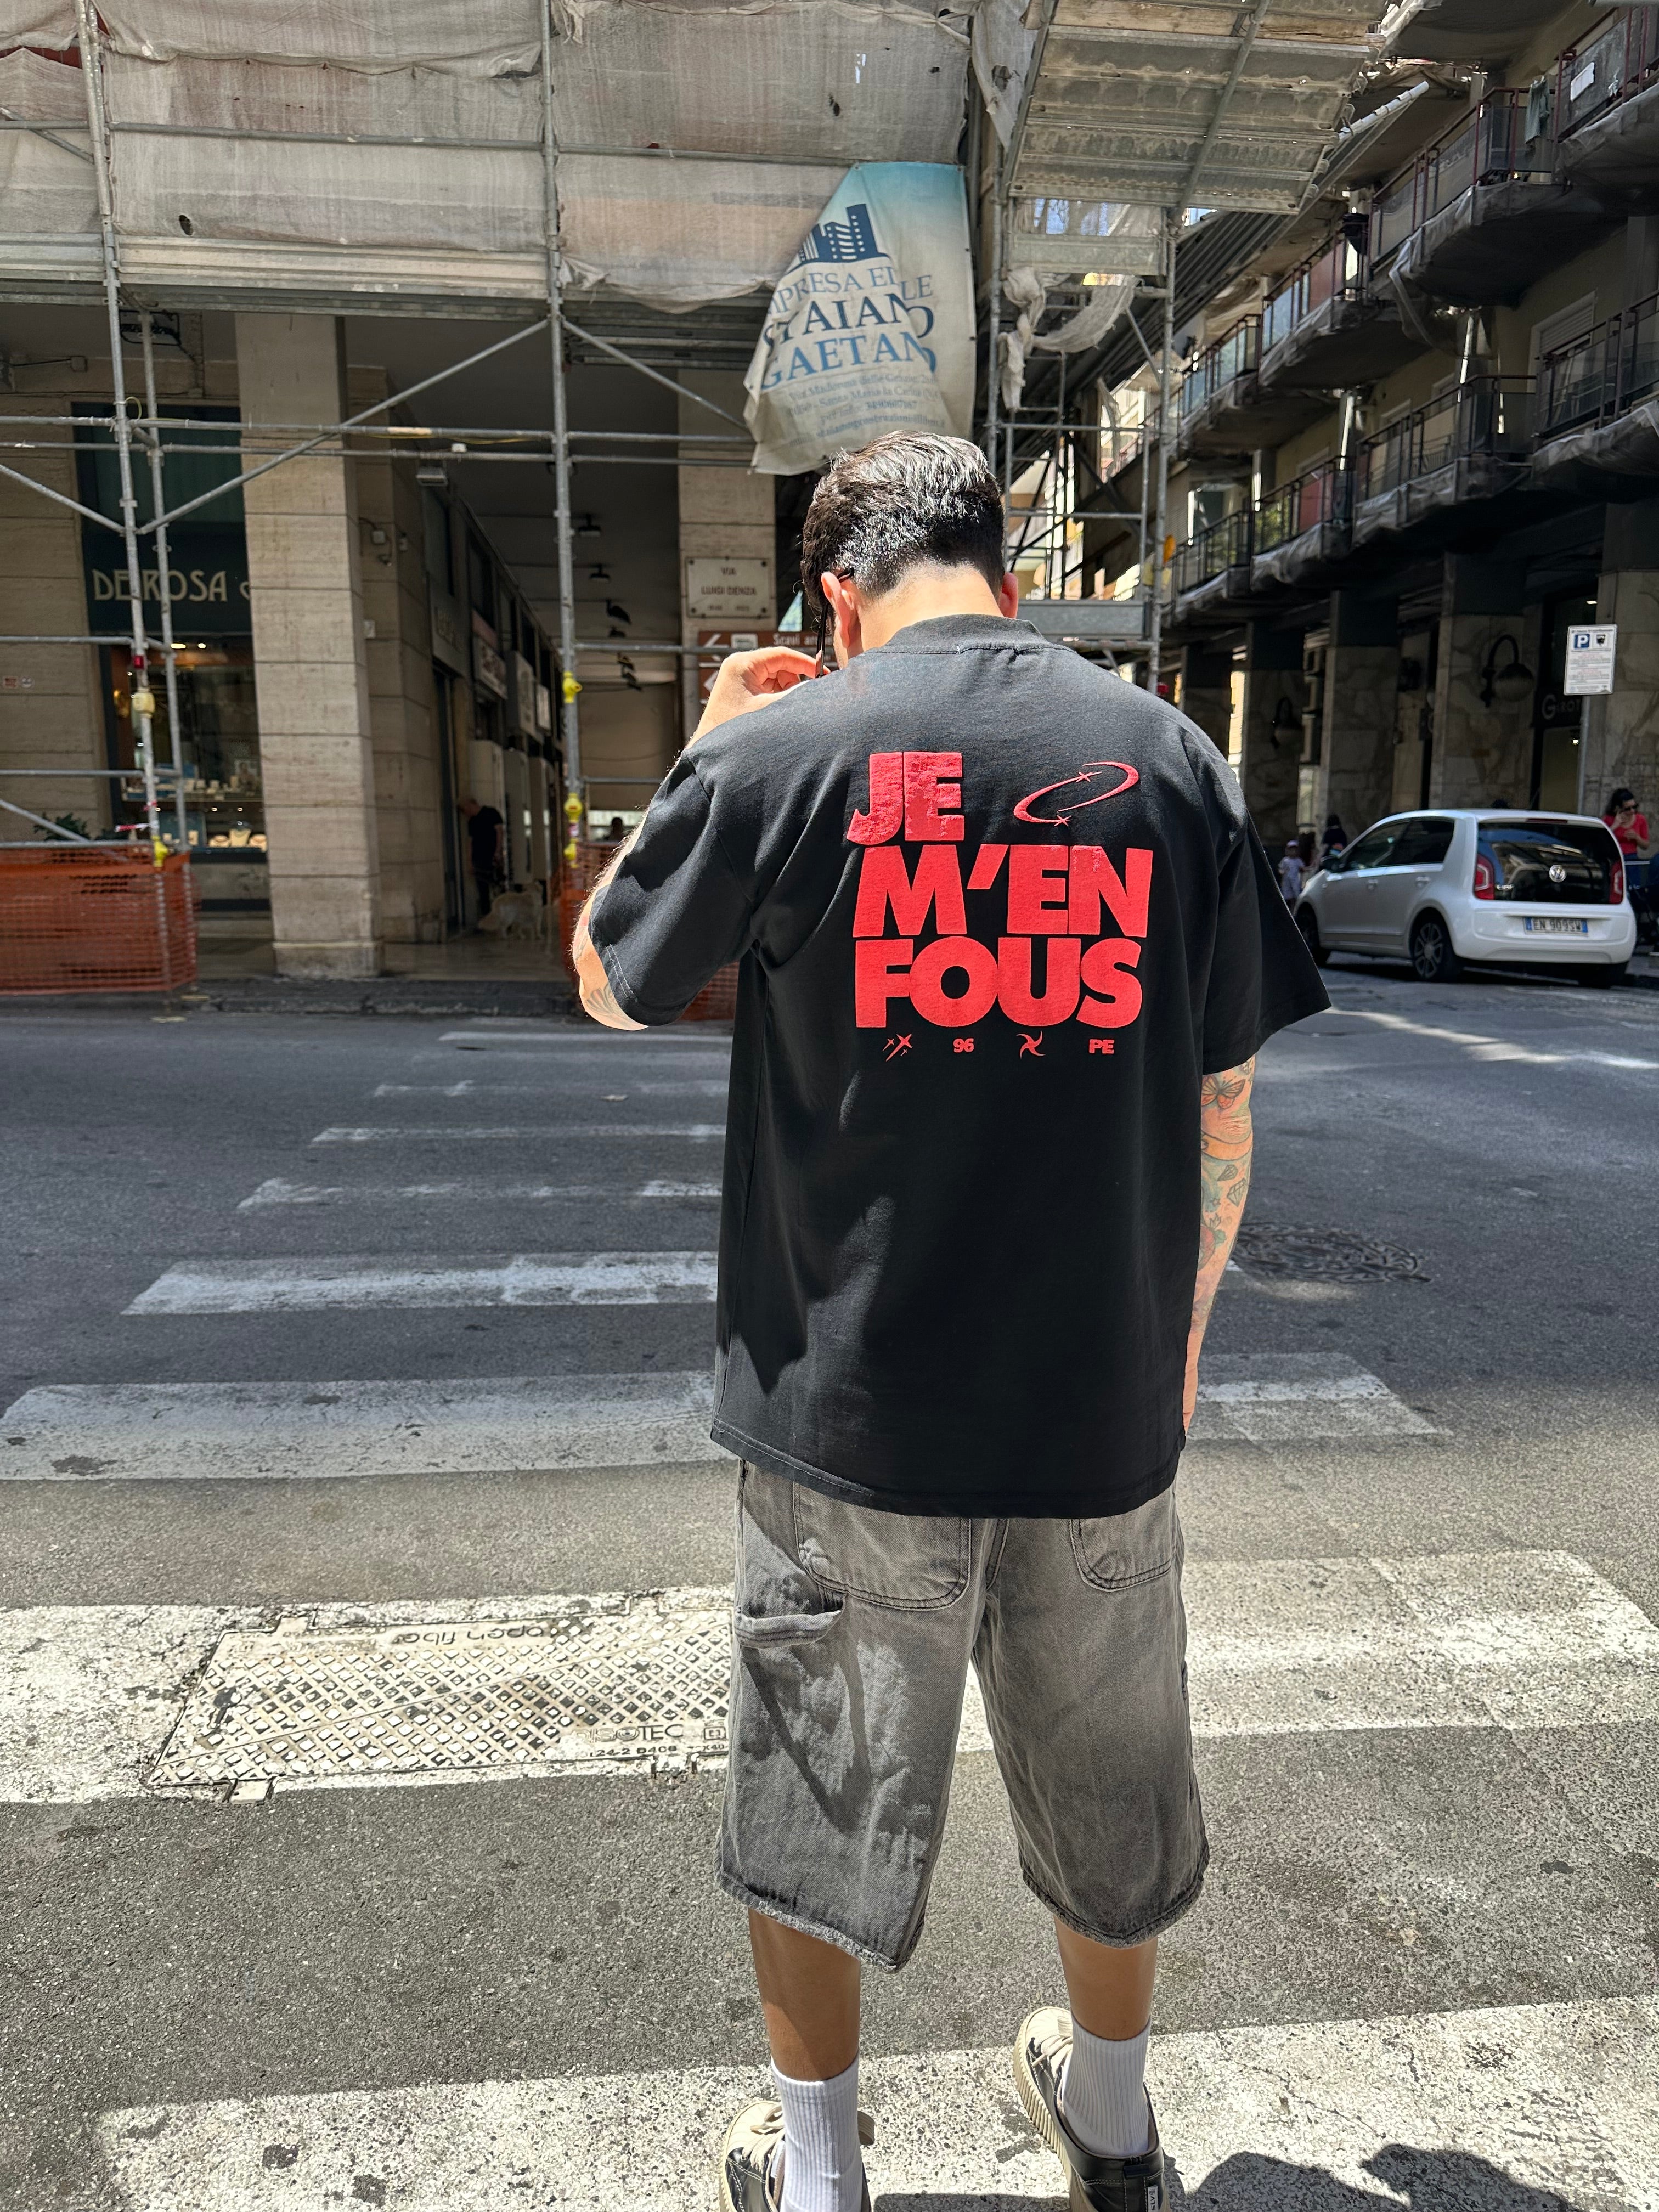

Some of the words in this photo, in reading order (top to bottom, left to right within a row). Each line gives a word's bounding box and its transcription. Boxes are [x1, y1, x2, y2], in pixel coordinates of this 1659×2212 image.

[141, 569, 228, 601] ROSA
[846, 751, 964, 845] JE
[852, 844, 1153, 938] M'EN
[856, 936, 1143, 1028] FOUS
[953, 1038, 974, 1052] 96
[1089, 1039, 1114, 1054] PE
